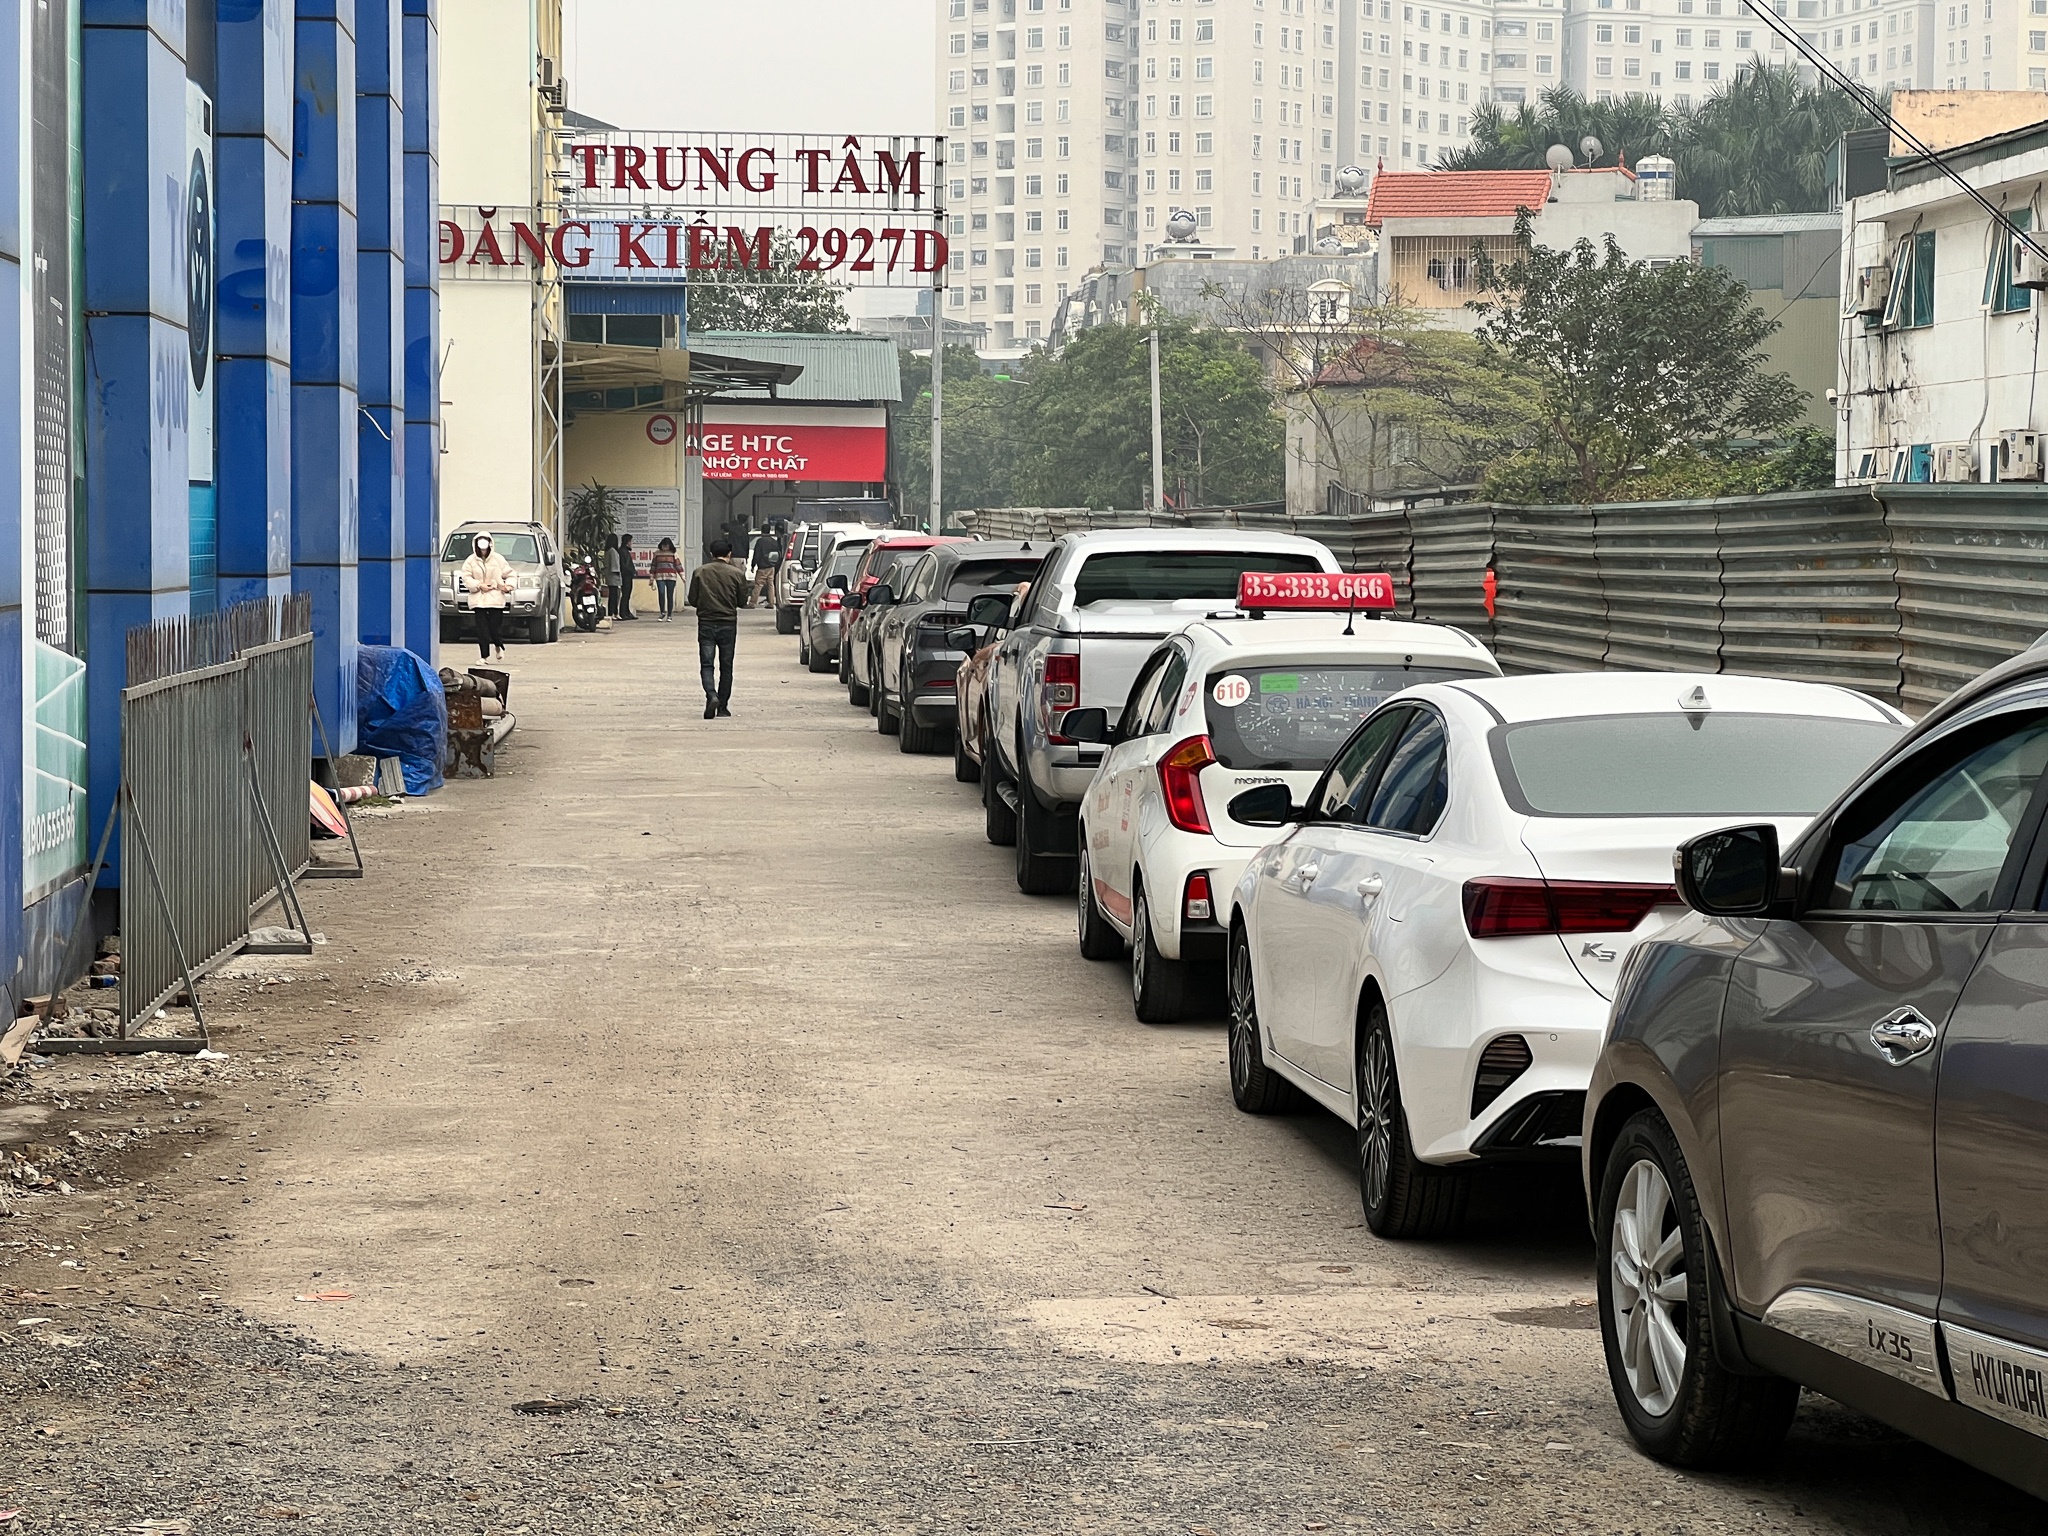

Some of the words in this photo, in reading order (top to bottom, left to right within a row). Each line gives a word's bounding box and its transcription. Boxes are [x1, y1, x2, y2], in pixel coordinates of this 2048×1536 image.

[571, 144, 779, 193] TRUNG
[795, 134, 926, 195] TÂM
[439, 206, 595, 268] ĐĂNG
[616, 209, 775, 271] KIỂM
[797, 226, 949, 273] 2927D
[742, 434, 793, 453] HTC
[757, 455, 809, 470] CHẤT
[1246, 575, 1384, 601] 35.333.666
[1216, 681, 1245, 700] 616
[1295, 694, 1311, 709] HÀ
[1581, 941, 1617, 963] K3
[1867, 1318, 1913, 1363] ix35
[1970, 1350, 2048, 1419] HYUNDAI
